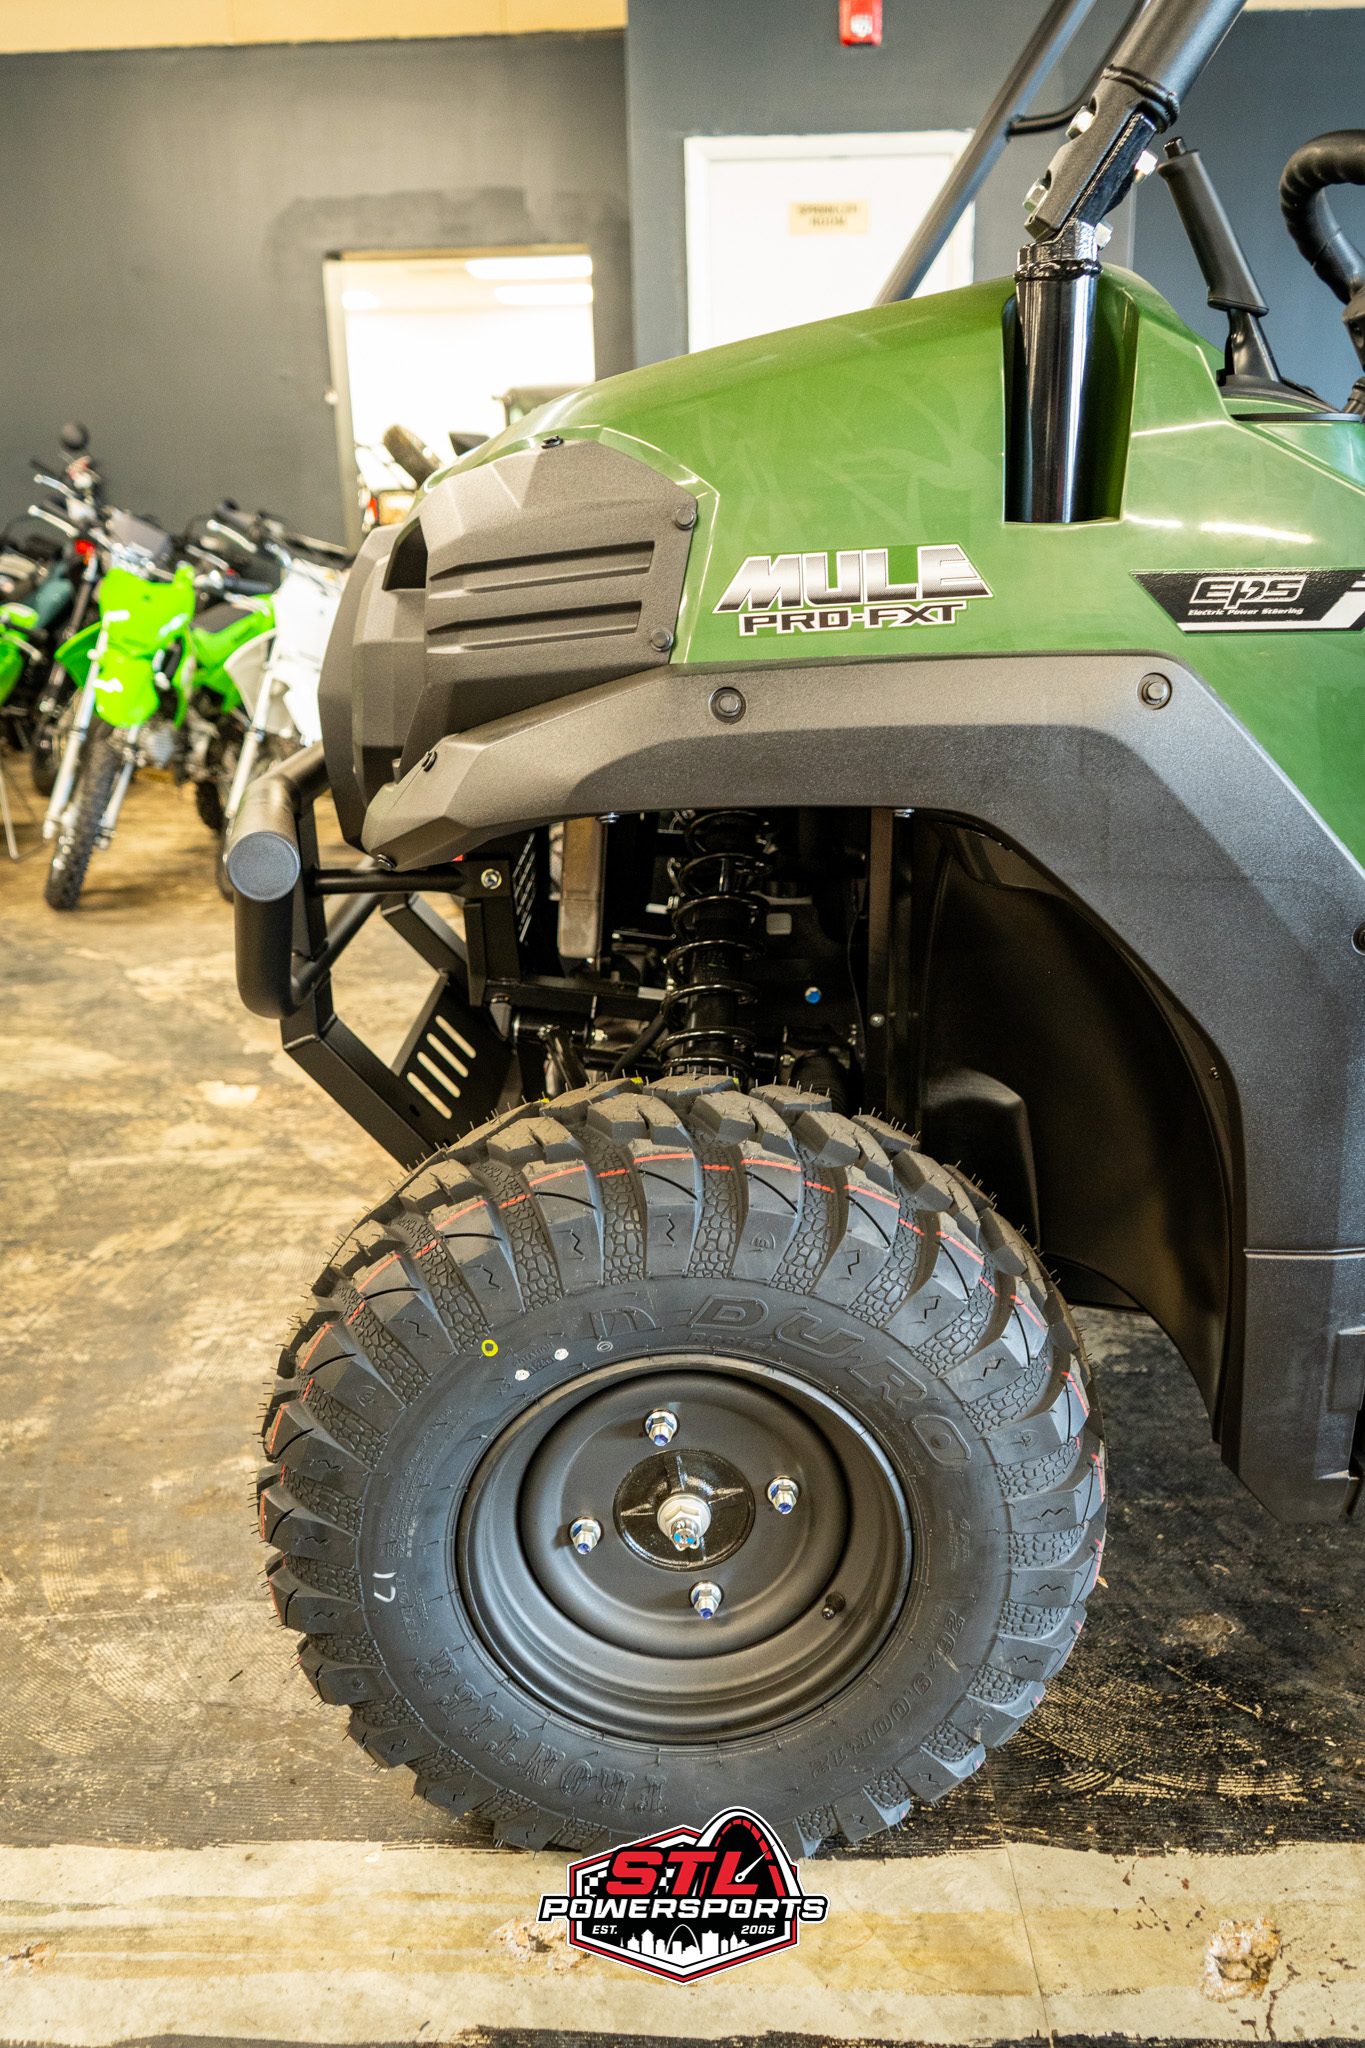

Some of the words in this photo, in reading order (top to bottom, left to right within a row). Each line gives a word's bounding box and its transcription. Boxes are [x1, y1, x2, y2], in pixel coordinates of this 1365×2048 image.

[712, 543, 994, 613] MULE
[1189, 575, 1307, 610] EPS
[738, 599, 968, 637] PRO-FXT
[1188, 608, 1225, 616] Electric
[1226, 608, 1259, 616] Power
[1261, 607, 1305, 616] Steering
[687, 1293, 974, 1465] DURO
